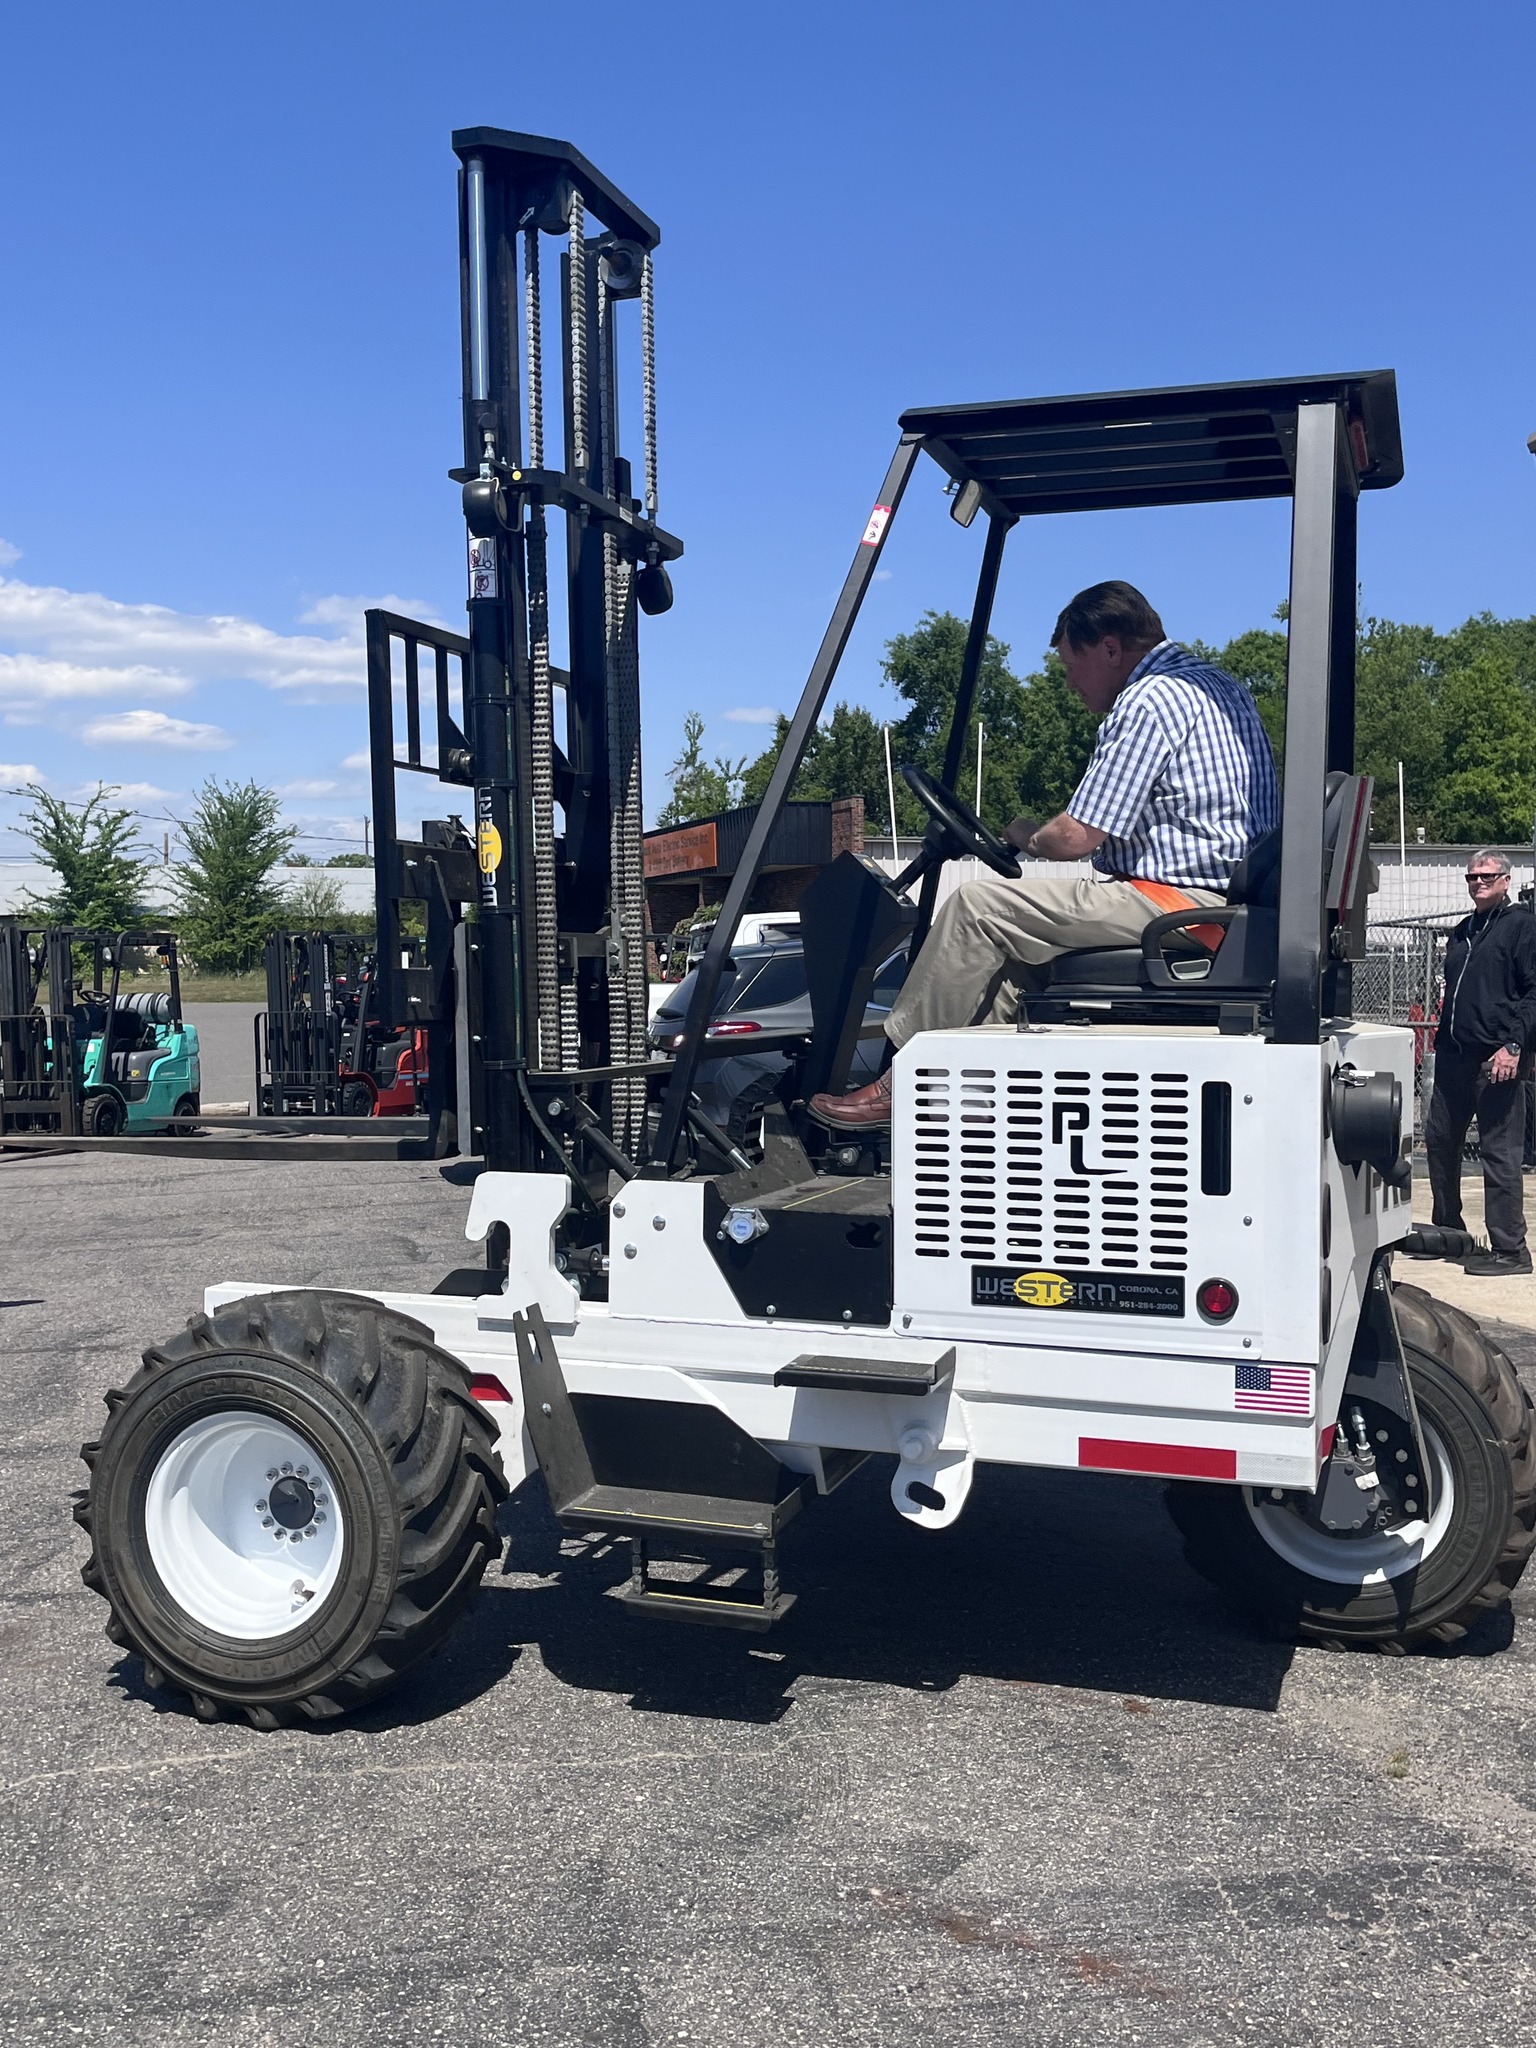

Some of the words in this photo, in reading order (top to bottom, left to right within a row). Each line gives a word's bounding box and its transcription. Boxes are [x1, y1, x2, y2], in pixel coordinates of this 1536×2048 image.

[479, 787, 498, 907] WESTERN
[680, 835, 698, 848] Service
[976, 1276, 1116, 1301] WESTERN
[1164, 1287, 1179, 1295] CA
[200, 1378, 300, 1412] GUARD
